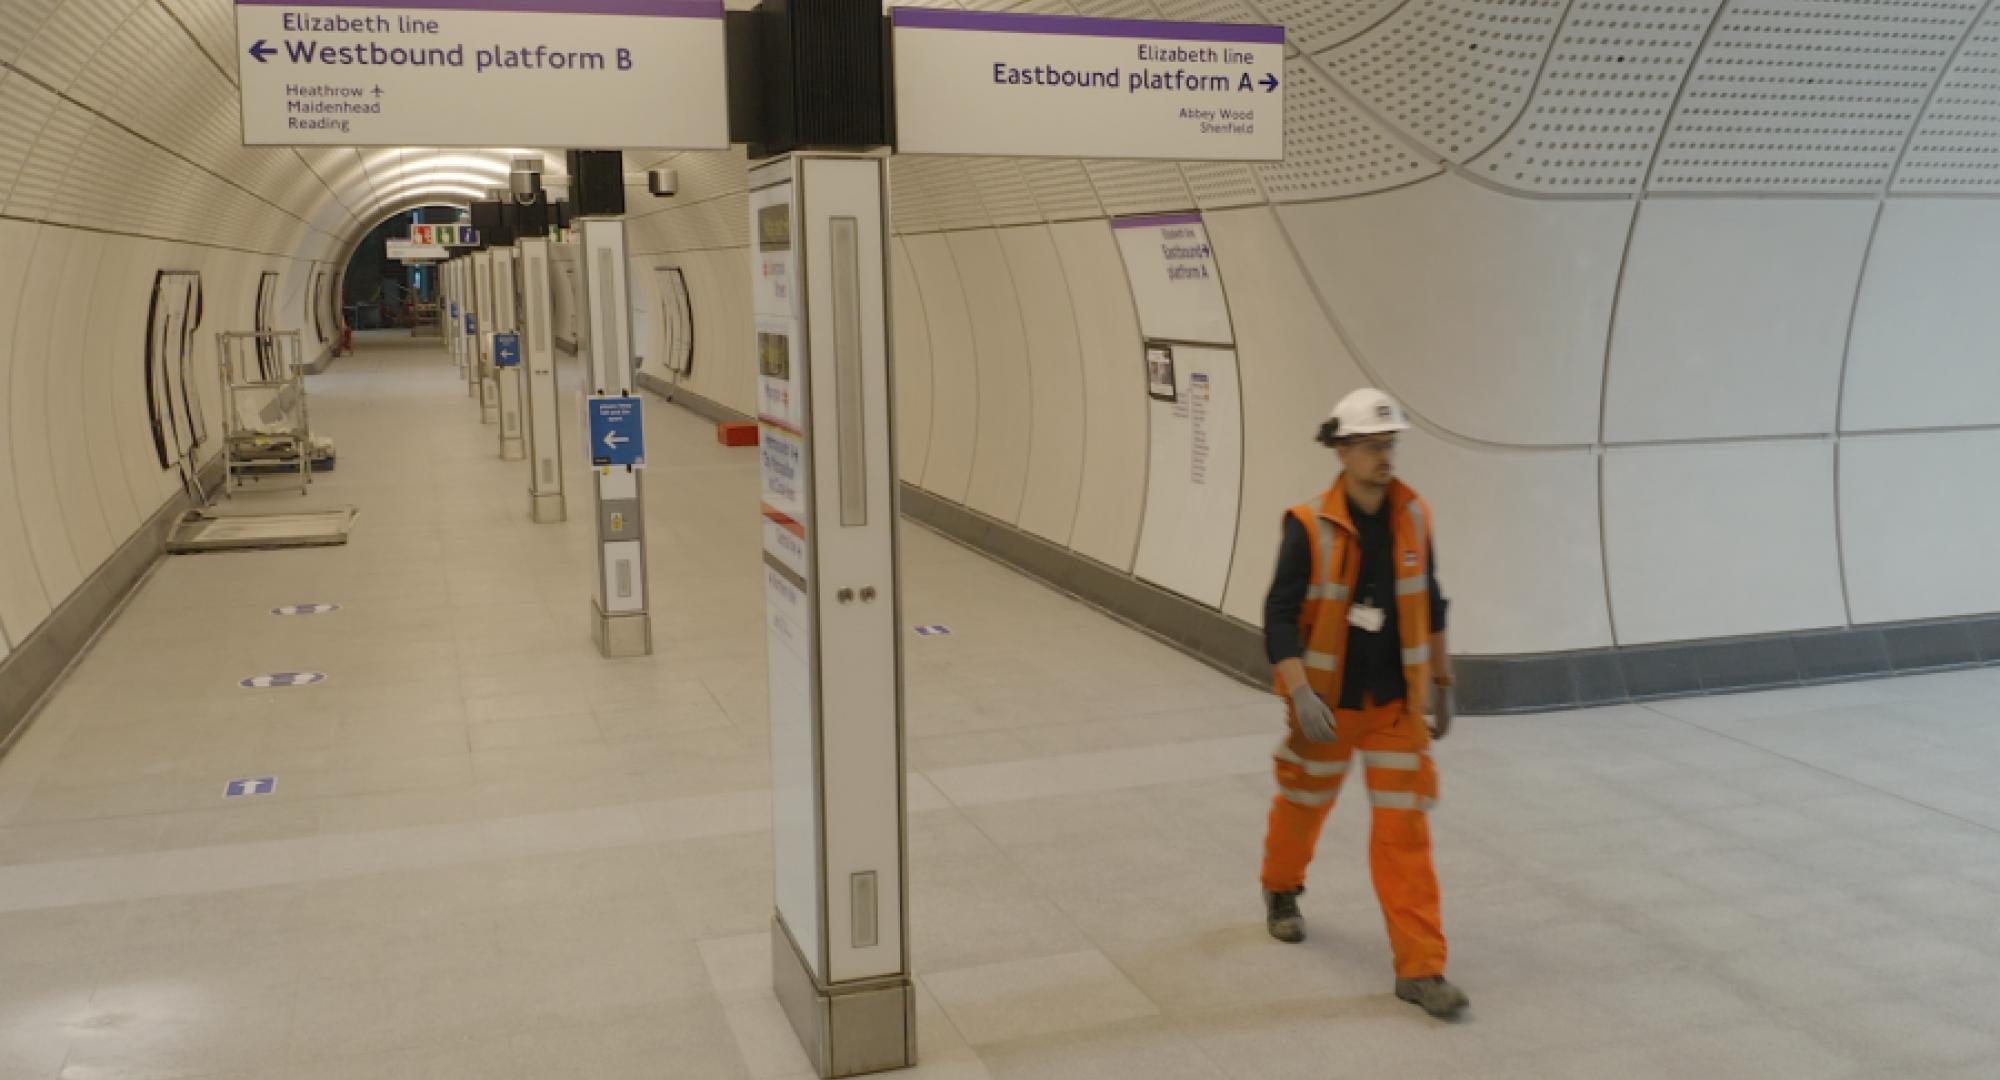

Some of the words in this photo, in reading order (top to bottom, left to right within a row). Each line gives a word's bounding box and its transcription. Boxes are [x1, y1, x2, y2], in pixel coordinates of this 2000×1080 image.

[282, 12, 390, 34] Elizabeth
[397, 15, 439, 34] line
[283, 39, 464, 67] Westbound
[475, 44, 605, 74] platform
[616, 47, 633, 72] B
[1137, 43, 1219, 63] Elizabeth
[1223, 47, 1254, 65] line
[992, 62, 1121, 89] Eastbound
[1128, 67, 1230, 94] platform
[1237, 72, 1254, 92] A
[285, 83, 363, 98] Heathrow
[287, 100, 381, 114] Maidenhead
[1179, 107, 1216, 122] Abbey
[1219, 108, 1254, 121] Wood
[287, 116, 350, 133] Reading
[1199, 121, 1254, 135] Shenfield
